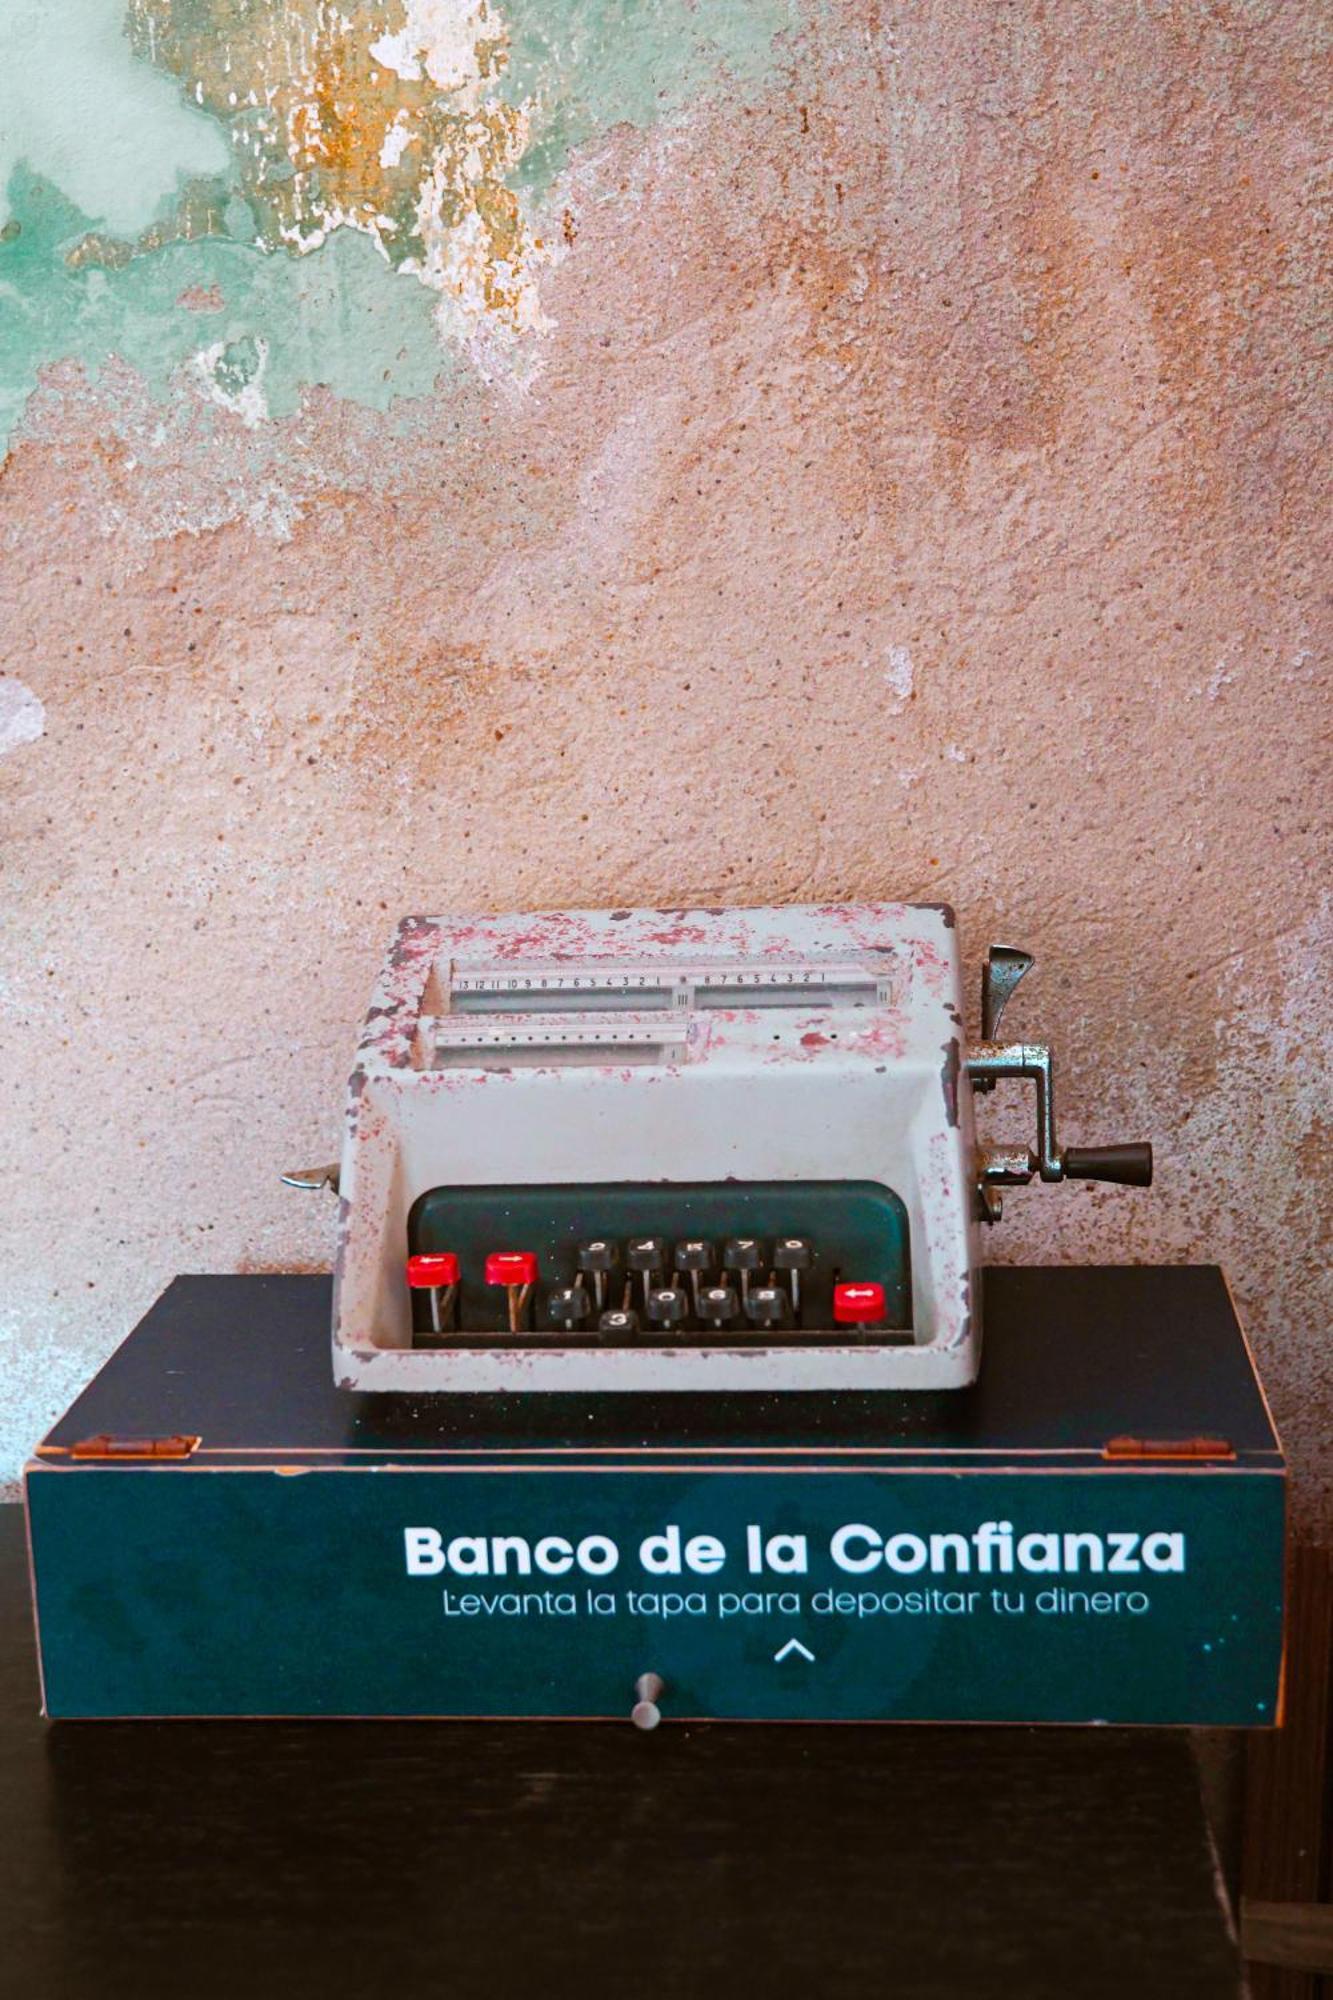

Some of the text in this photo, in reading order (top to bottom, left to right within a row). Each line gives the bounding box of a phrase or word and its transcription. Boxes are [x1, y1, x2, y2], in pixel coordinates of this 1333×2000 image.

[459, 980, 469, 989] 13
[475, 980, 485, 989] 12
[491, 980, 500, 989] 11
[508, 979, 518, 988] 10
[525, 979, 531, 988] 9
[558, 978, 564, 987] 7
[574, 978, 580, 987] 6
[590, 978, 596, 987] 5
[606, 977, 613, 986] 4
[623, 977, 629, 986] 3
[639, 976, 645, 986] 2
[720, 975, 727, 984] 7
[737, 974, 743, 983] 6
[754, 974, 760, 983] 5
[770, 973, 776, 982] 4
[787, 973, 793, 982] 3
[803, 973, 810, 982] 2
[637, 1241, 655, 1250] 4
[737, 1240, 755, 1250] 7
[609, 1313, 627, 1326] 3
[403, 1520, 1185, 1576] Banco de la Confianza
[442, 1587, 1149, 1619] Levanta la tapa para depositar tu dinero
